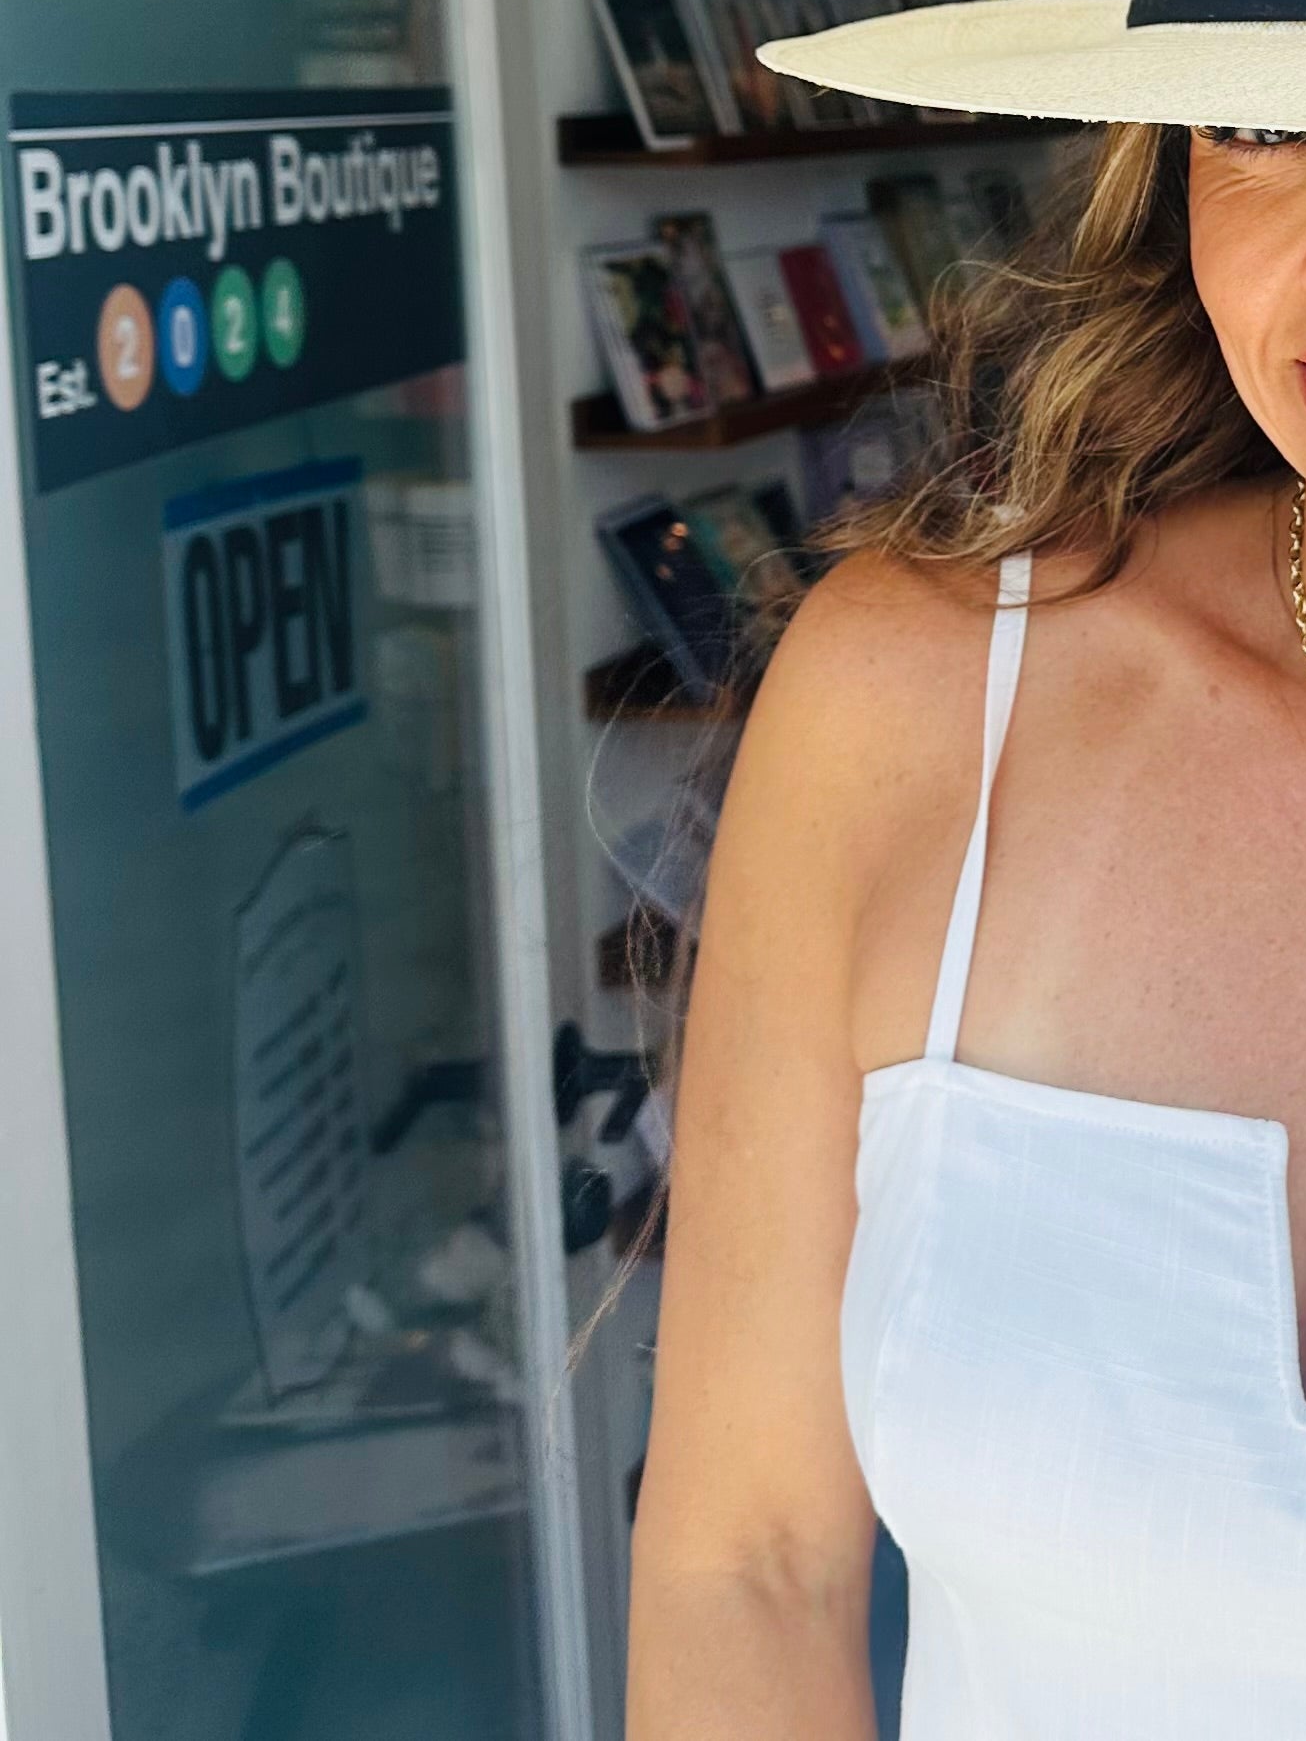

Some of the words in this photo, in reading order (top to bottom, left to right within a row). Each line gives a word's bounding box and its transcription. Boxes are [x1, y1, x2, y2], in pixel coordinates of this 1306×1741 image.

[18, 139, 262, 261] Brooklyn
[270, 134, 441, 233] Boutique
[36, 358, 97, 420] Est.
[184, 498, 352, 763] OPEN
